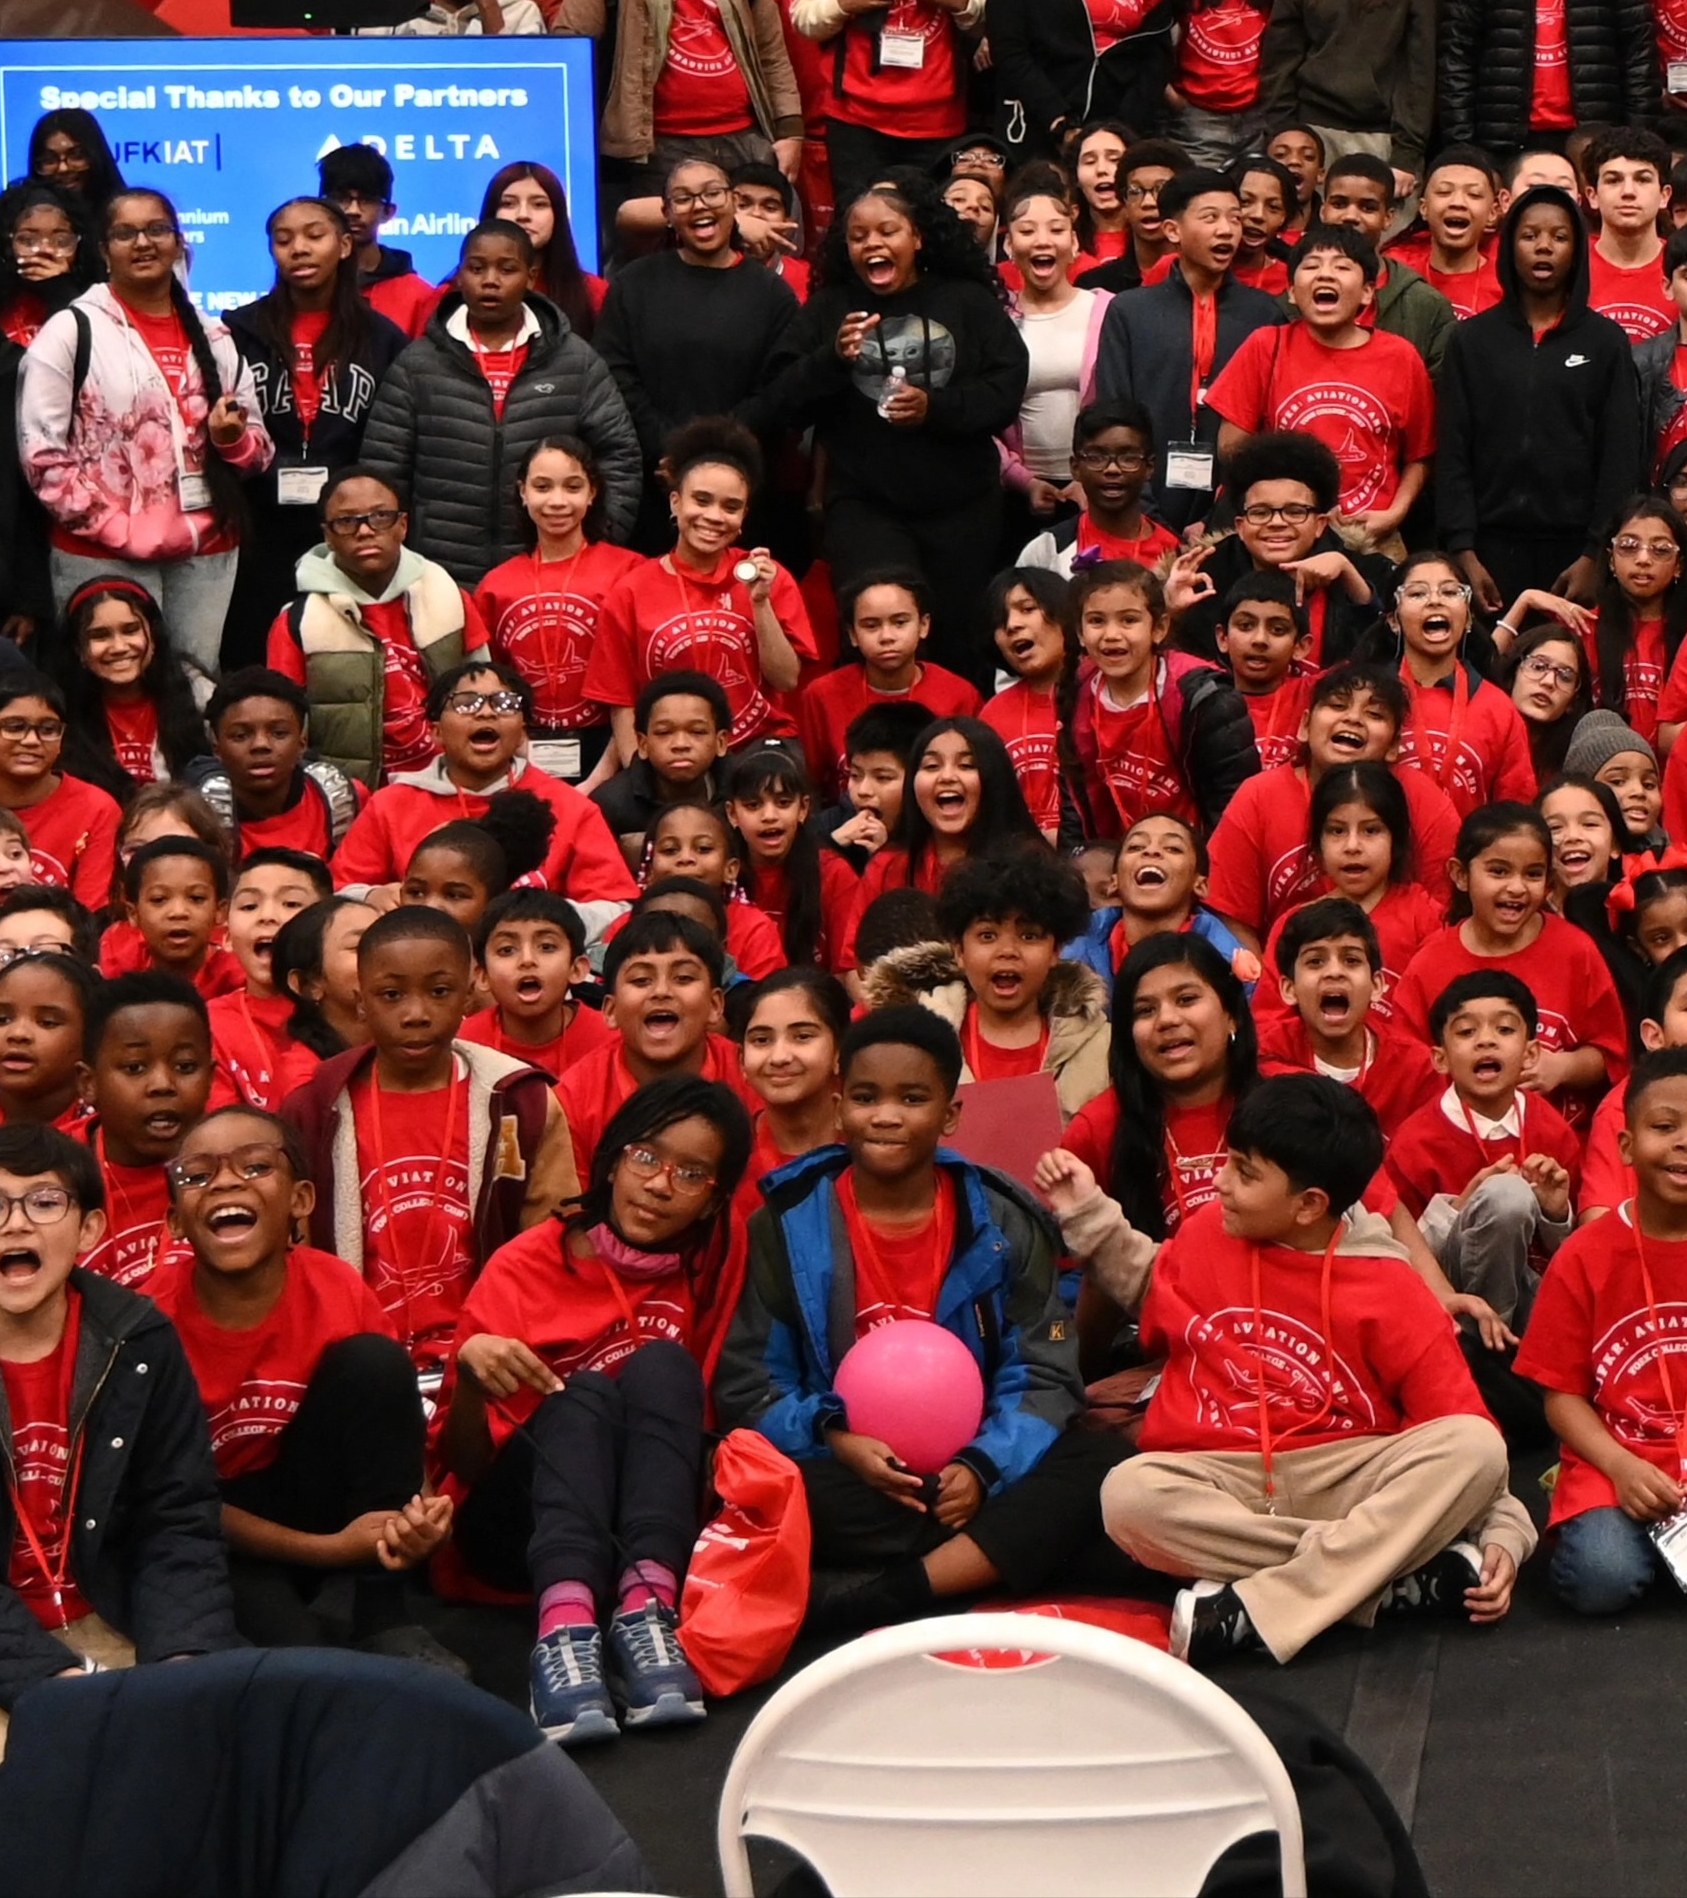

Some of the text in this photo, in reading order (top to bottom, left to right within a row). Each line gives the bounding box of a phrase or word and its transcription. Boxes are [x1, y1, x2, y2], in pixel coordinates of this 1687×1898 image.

[39, 84, 529, 111] Special Thanks to Our Partners
[373, 134, 501, 160] DELTA
[1322, 1369, 1350, 1405] AND
